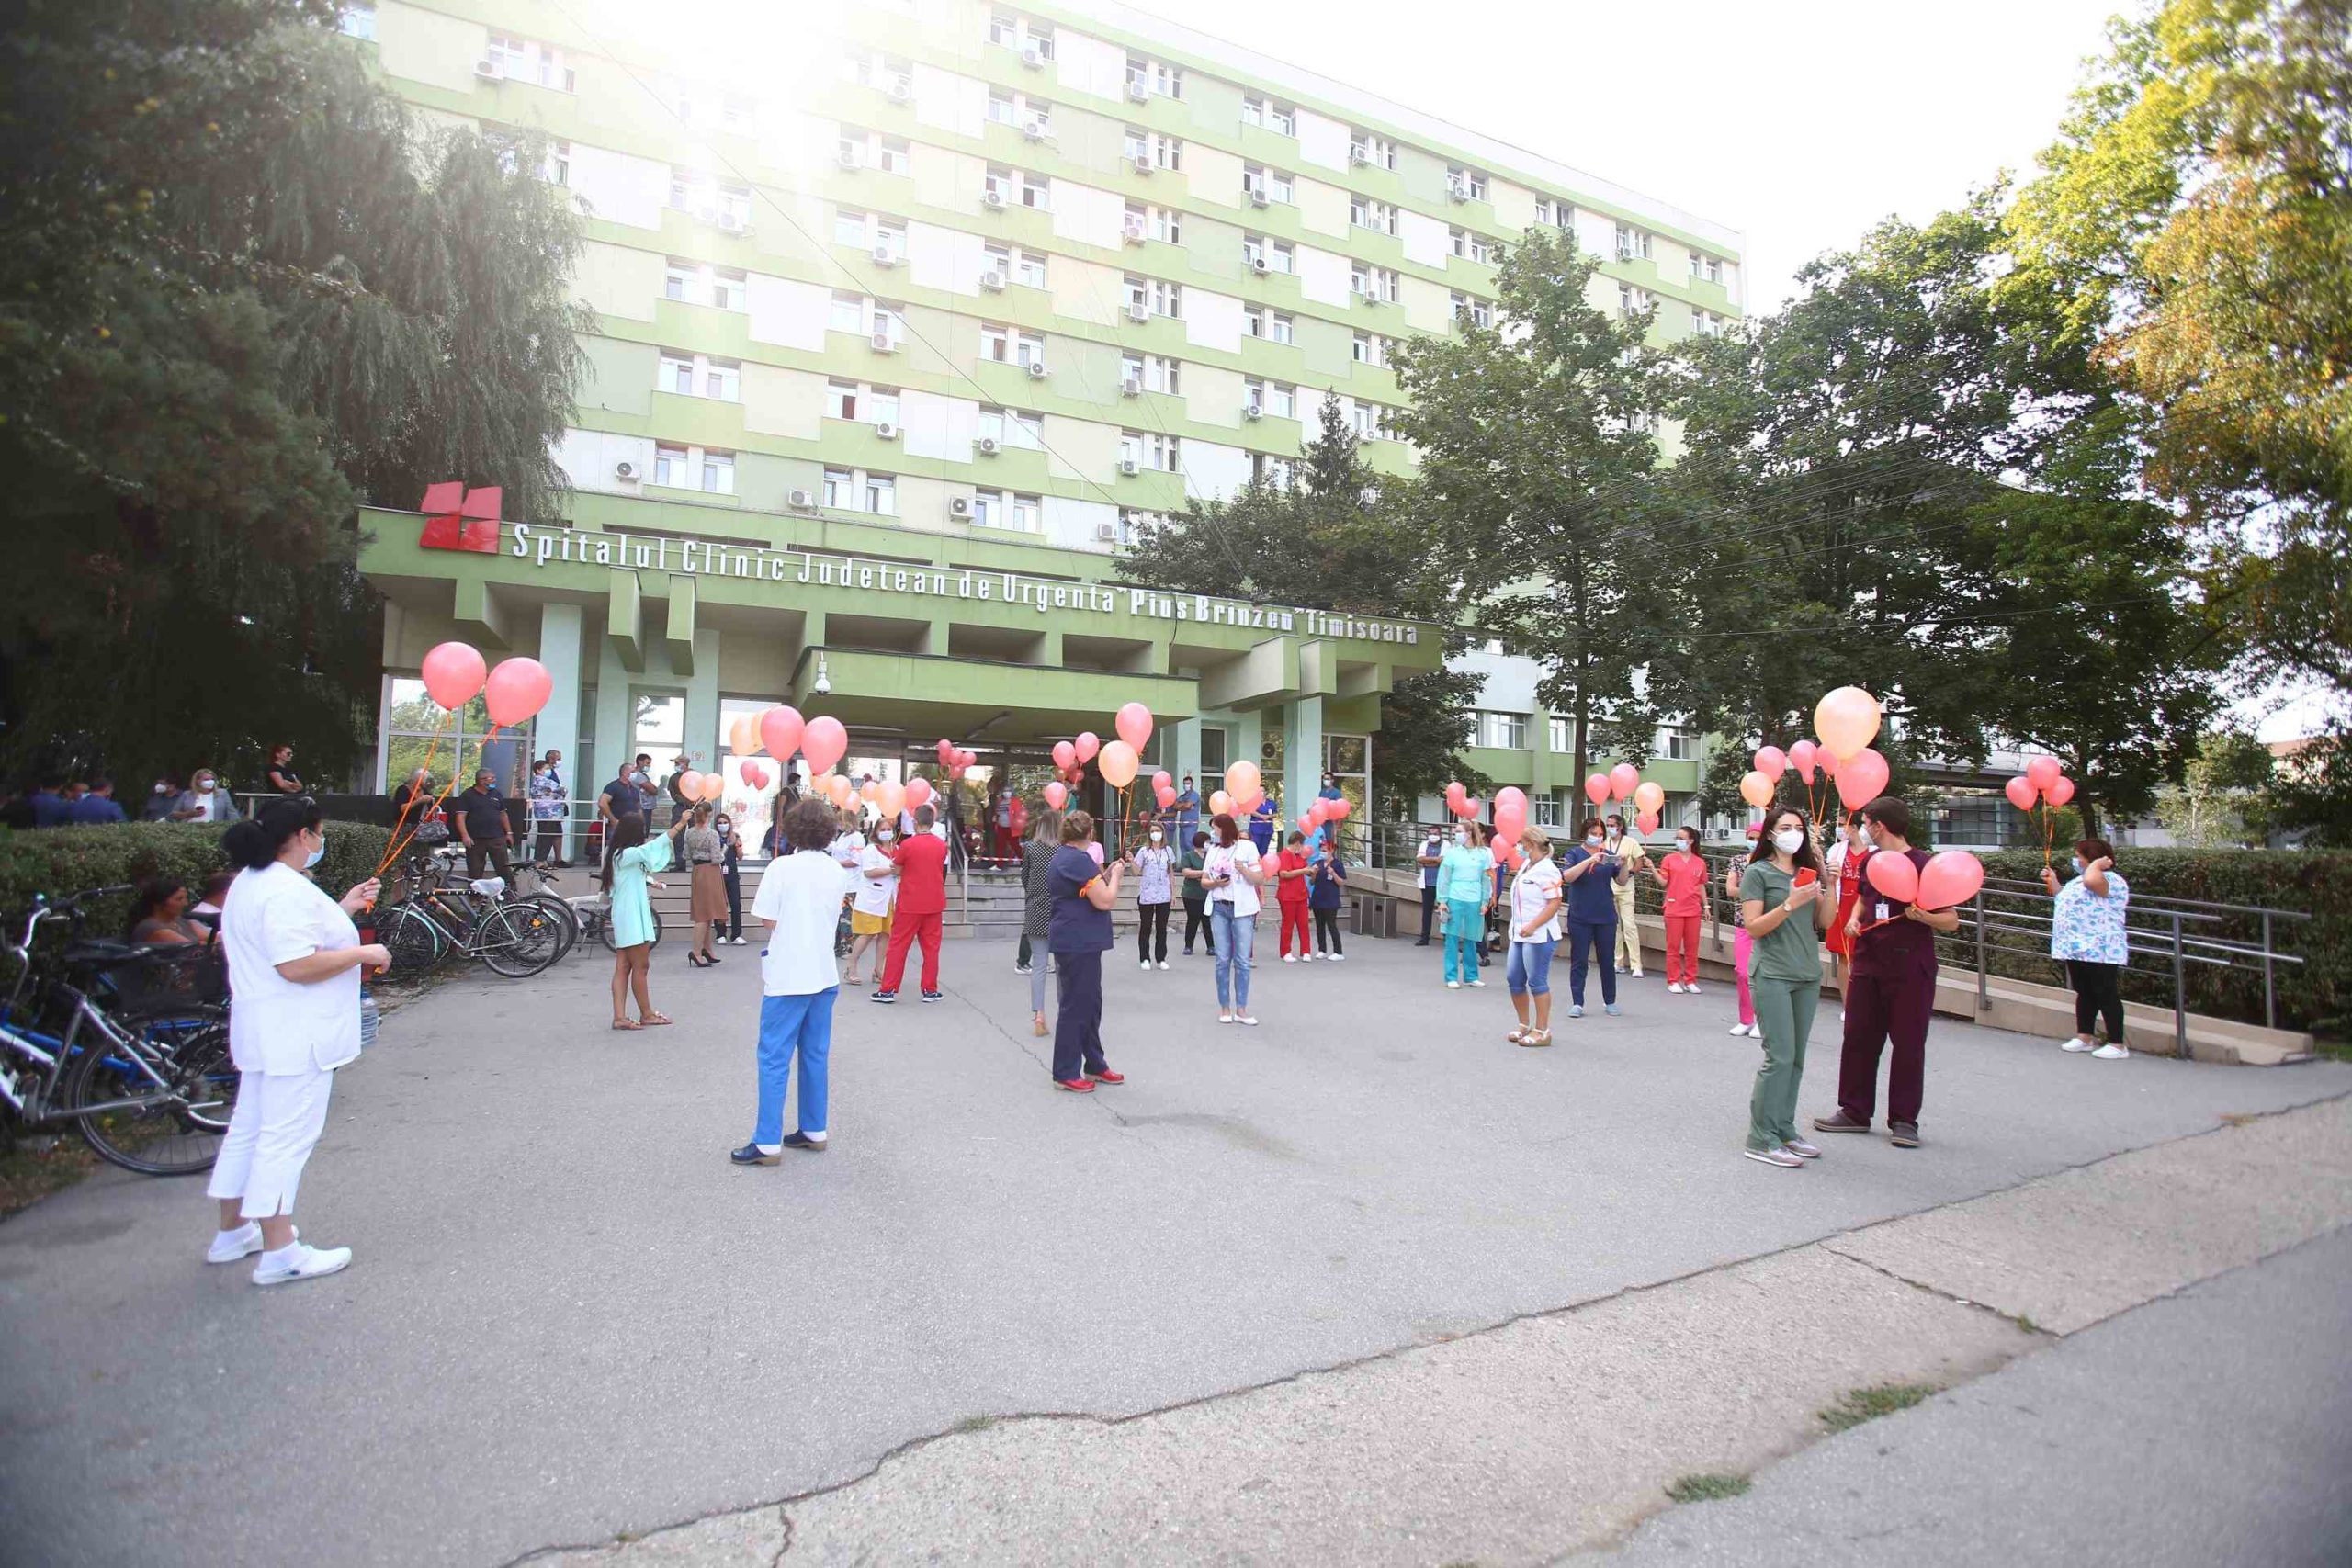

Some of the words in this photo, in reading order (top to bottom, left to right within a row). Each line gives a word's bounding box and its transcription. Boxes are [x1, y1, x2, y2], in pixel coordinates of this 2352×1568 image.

[513, 524, 666, 569] Spitalul
[683, 540, 784, 581] Clinic
[797, 553, 945, 595] Judetean
[959, 570, 989, 599] de
[1003, 574, 1114, 612] Urgenta
[1306, 609, 1418, 644] Timisoara
